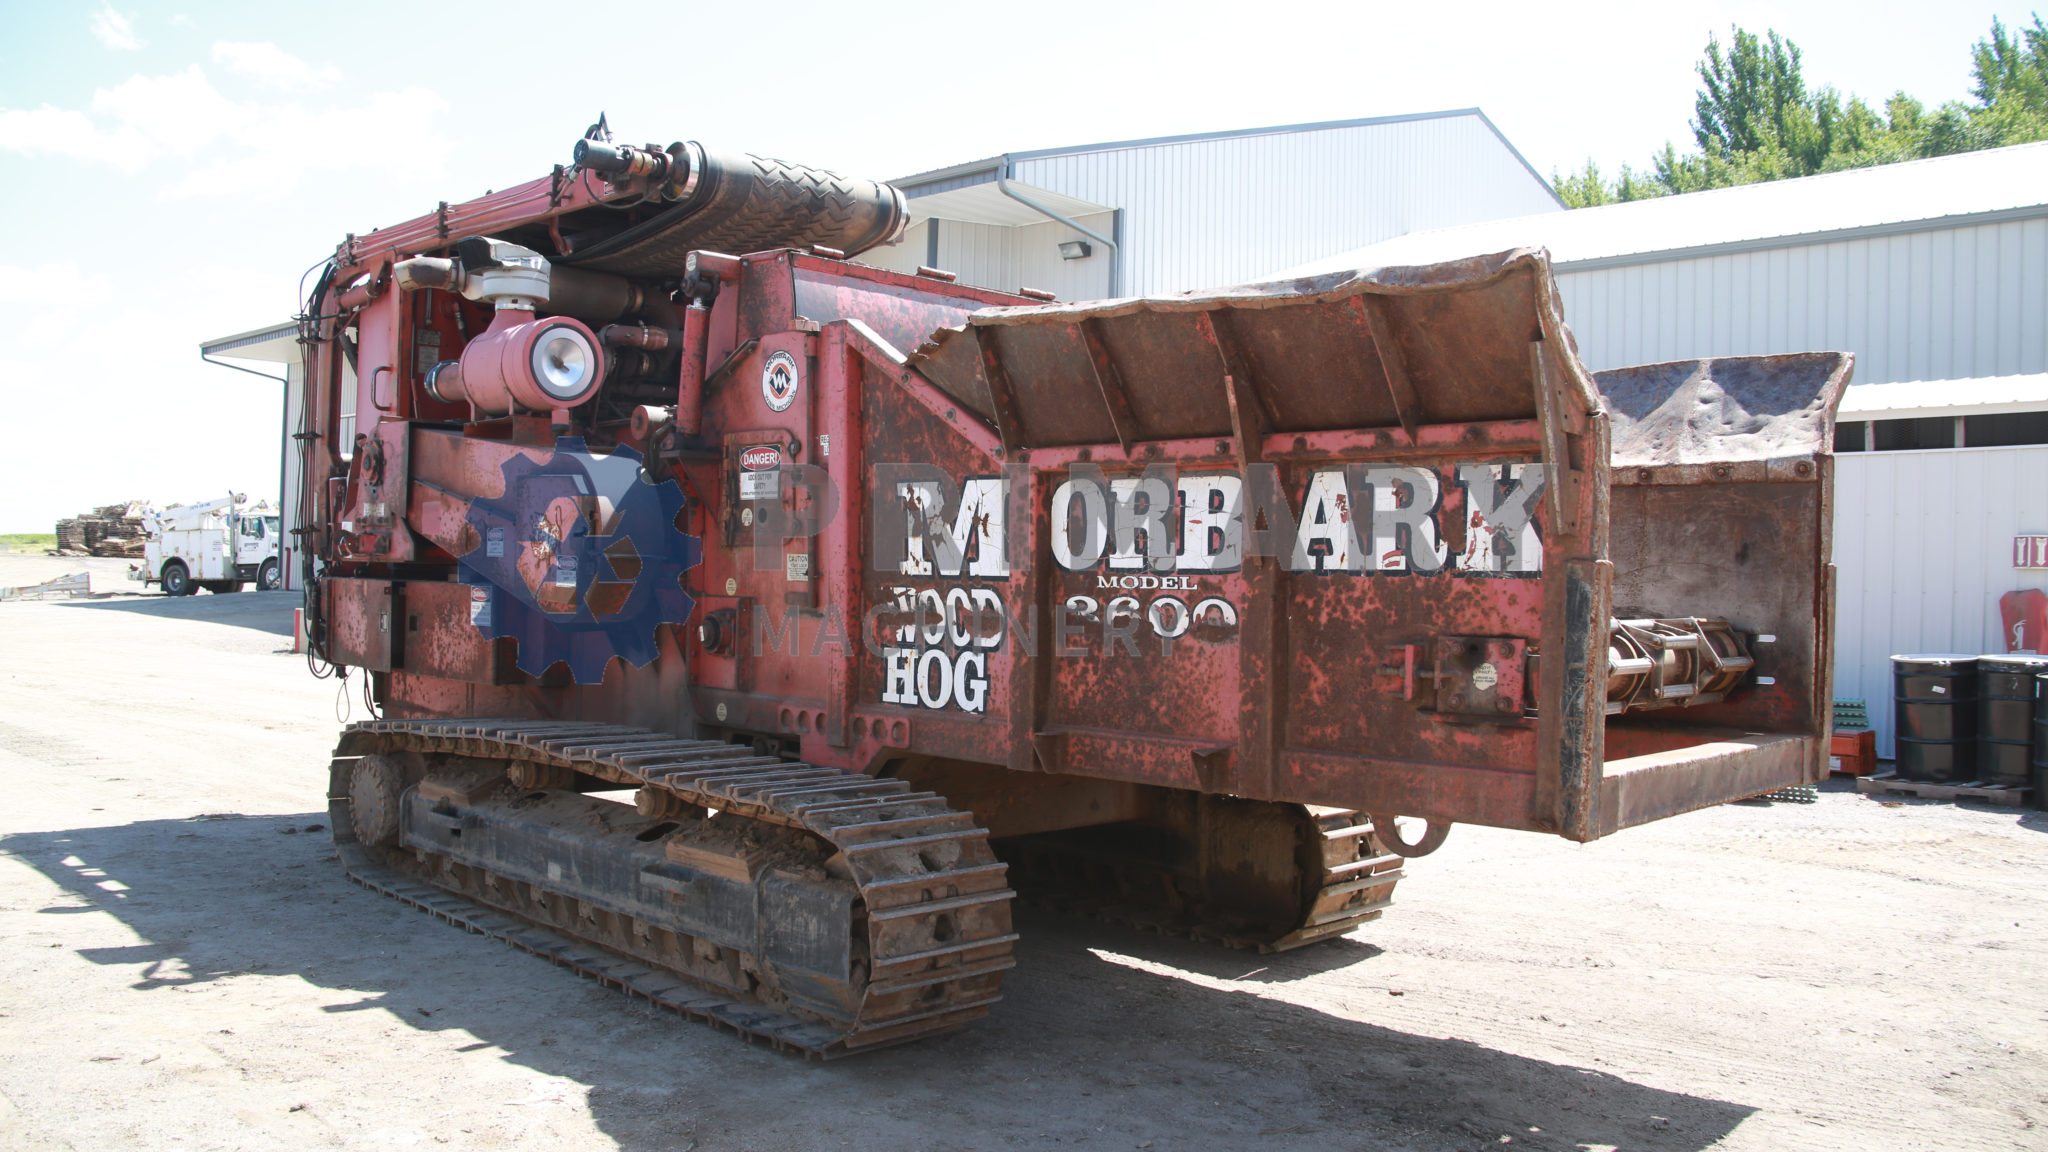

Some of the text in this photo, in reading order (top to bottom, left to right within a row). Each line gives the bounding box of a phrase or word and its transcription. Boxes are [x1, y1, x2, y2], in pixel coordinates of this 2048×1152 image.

[743, 452, 778, 466] DANGER!
[1097, 576, 1197, 590] MODEL
[882, 648, 988, 713] HOG
